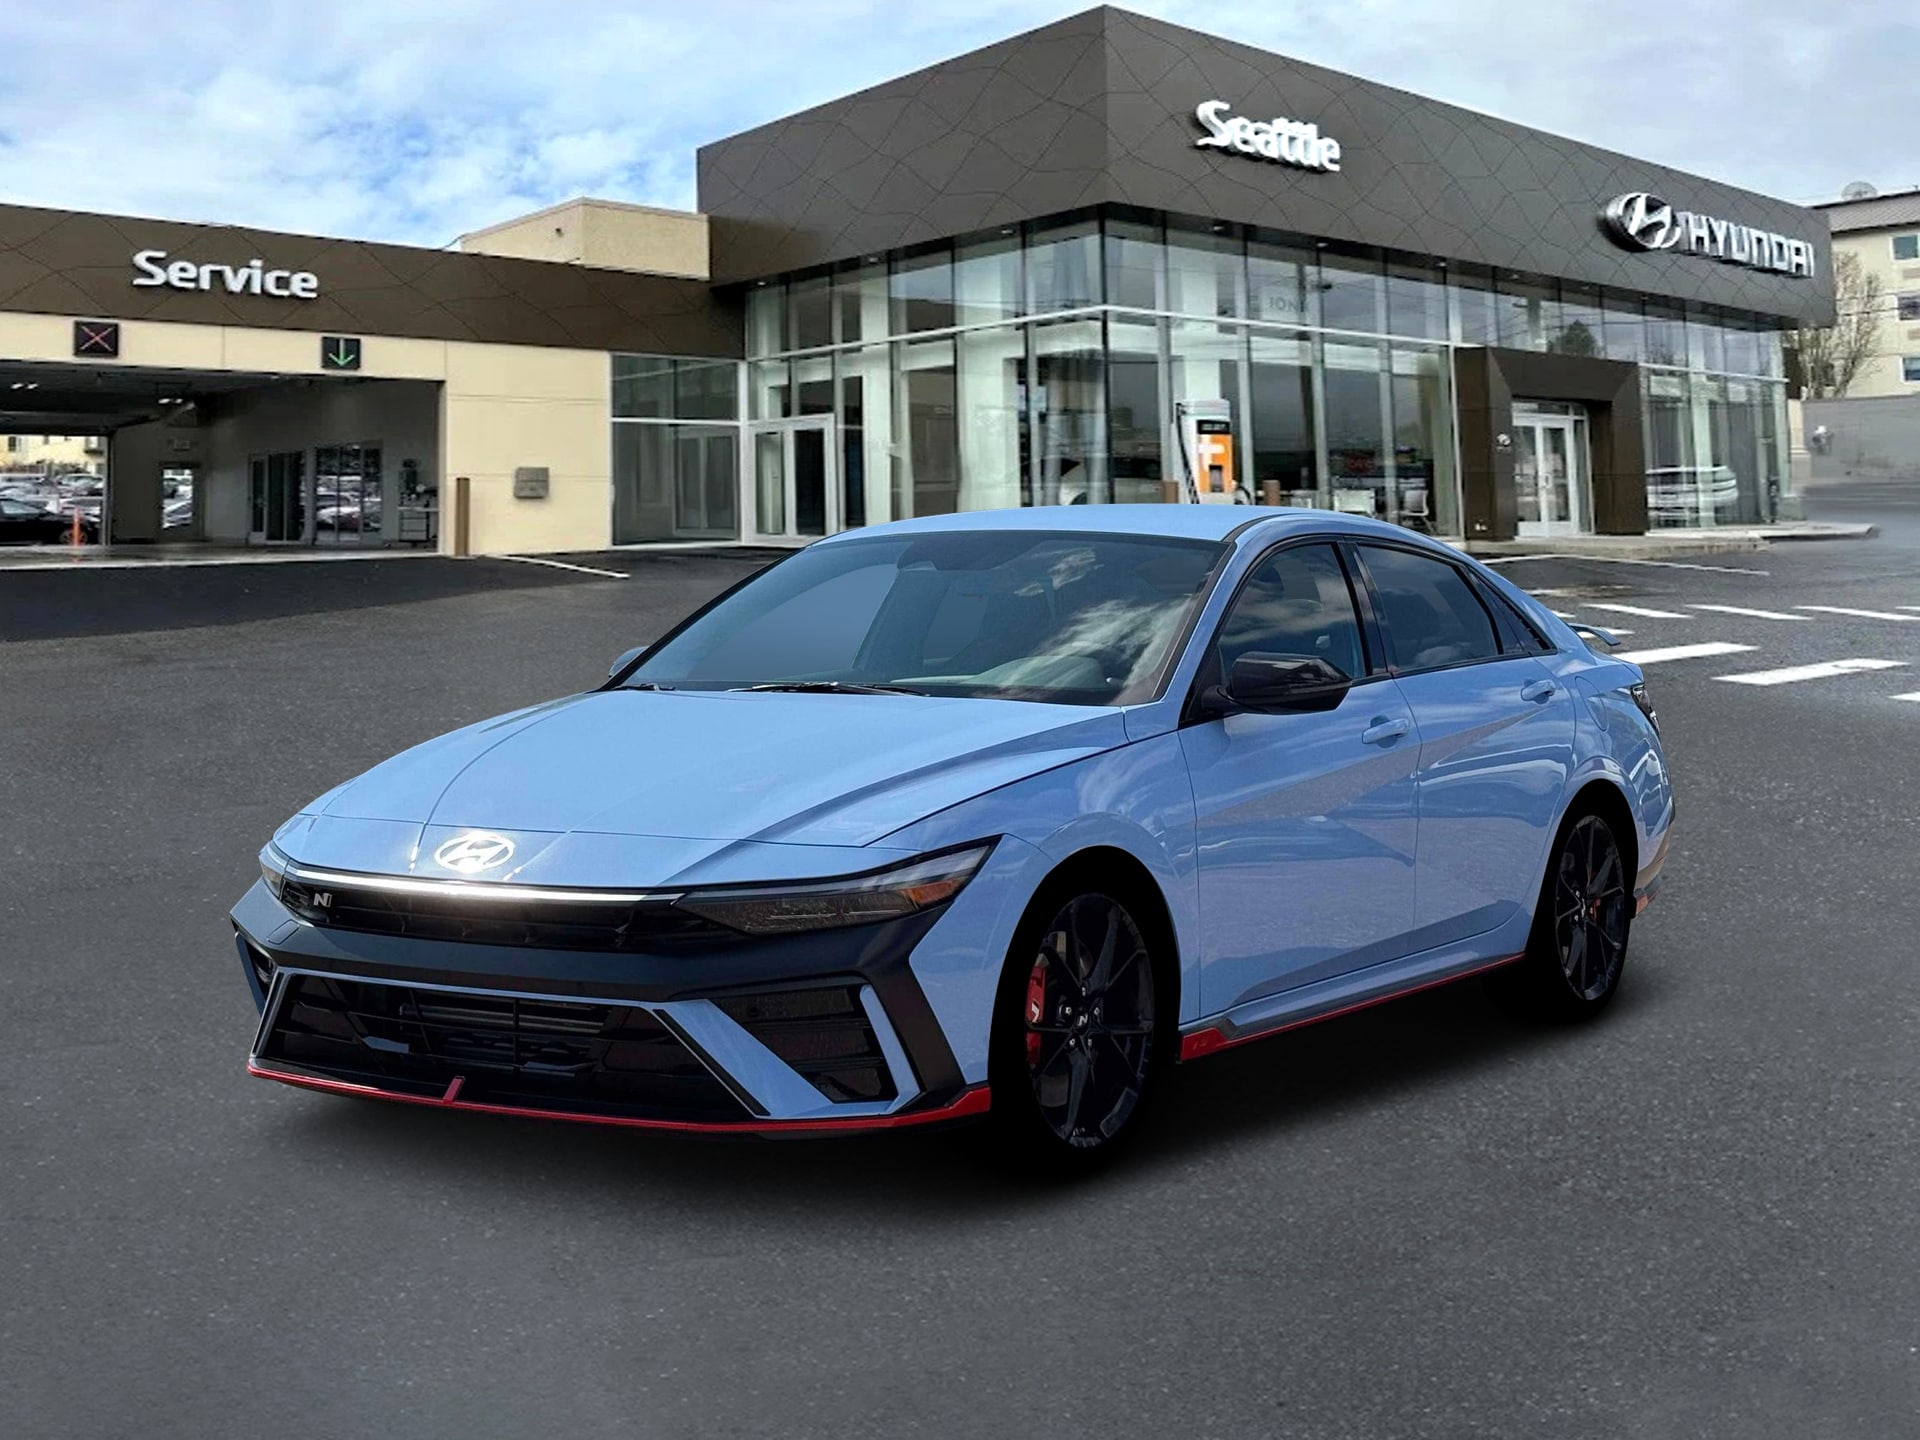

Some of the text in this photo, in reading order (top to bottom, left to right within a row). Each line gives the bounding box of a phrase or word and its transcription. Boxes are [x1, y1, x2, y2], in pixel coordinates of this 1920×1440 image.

[1196, 100, 1341, 172] Seattle
[132, 249, 318, 298] Service
[1677, 211, 1814, 278] HYUNDAI
